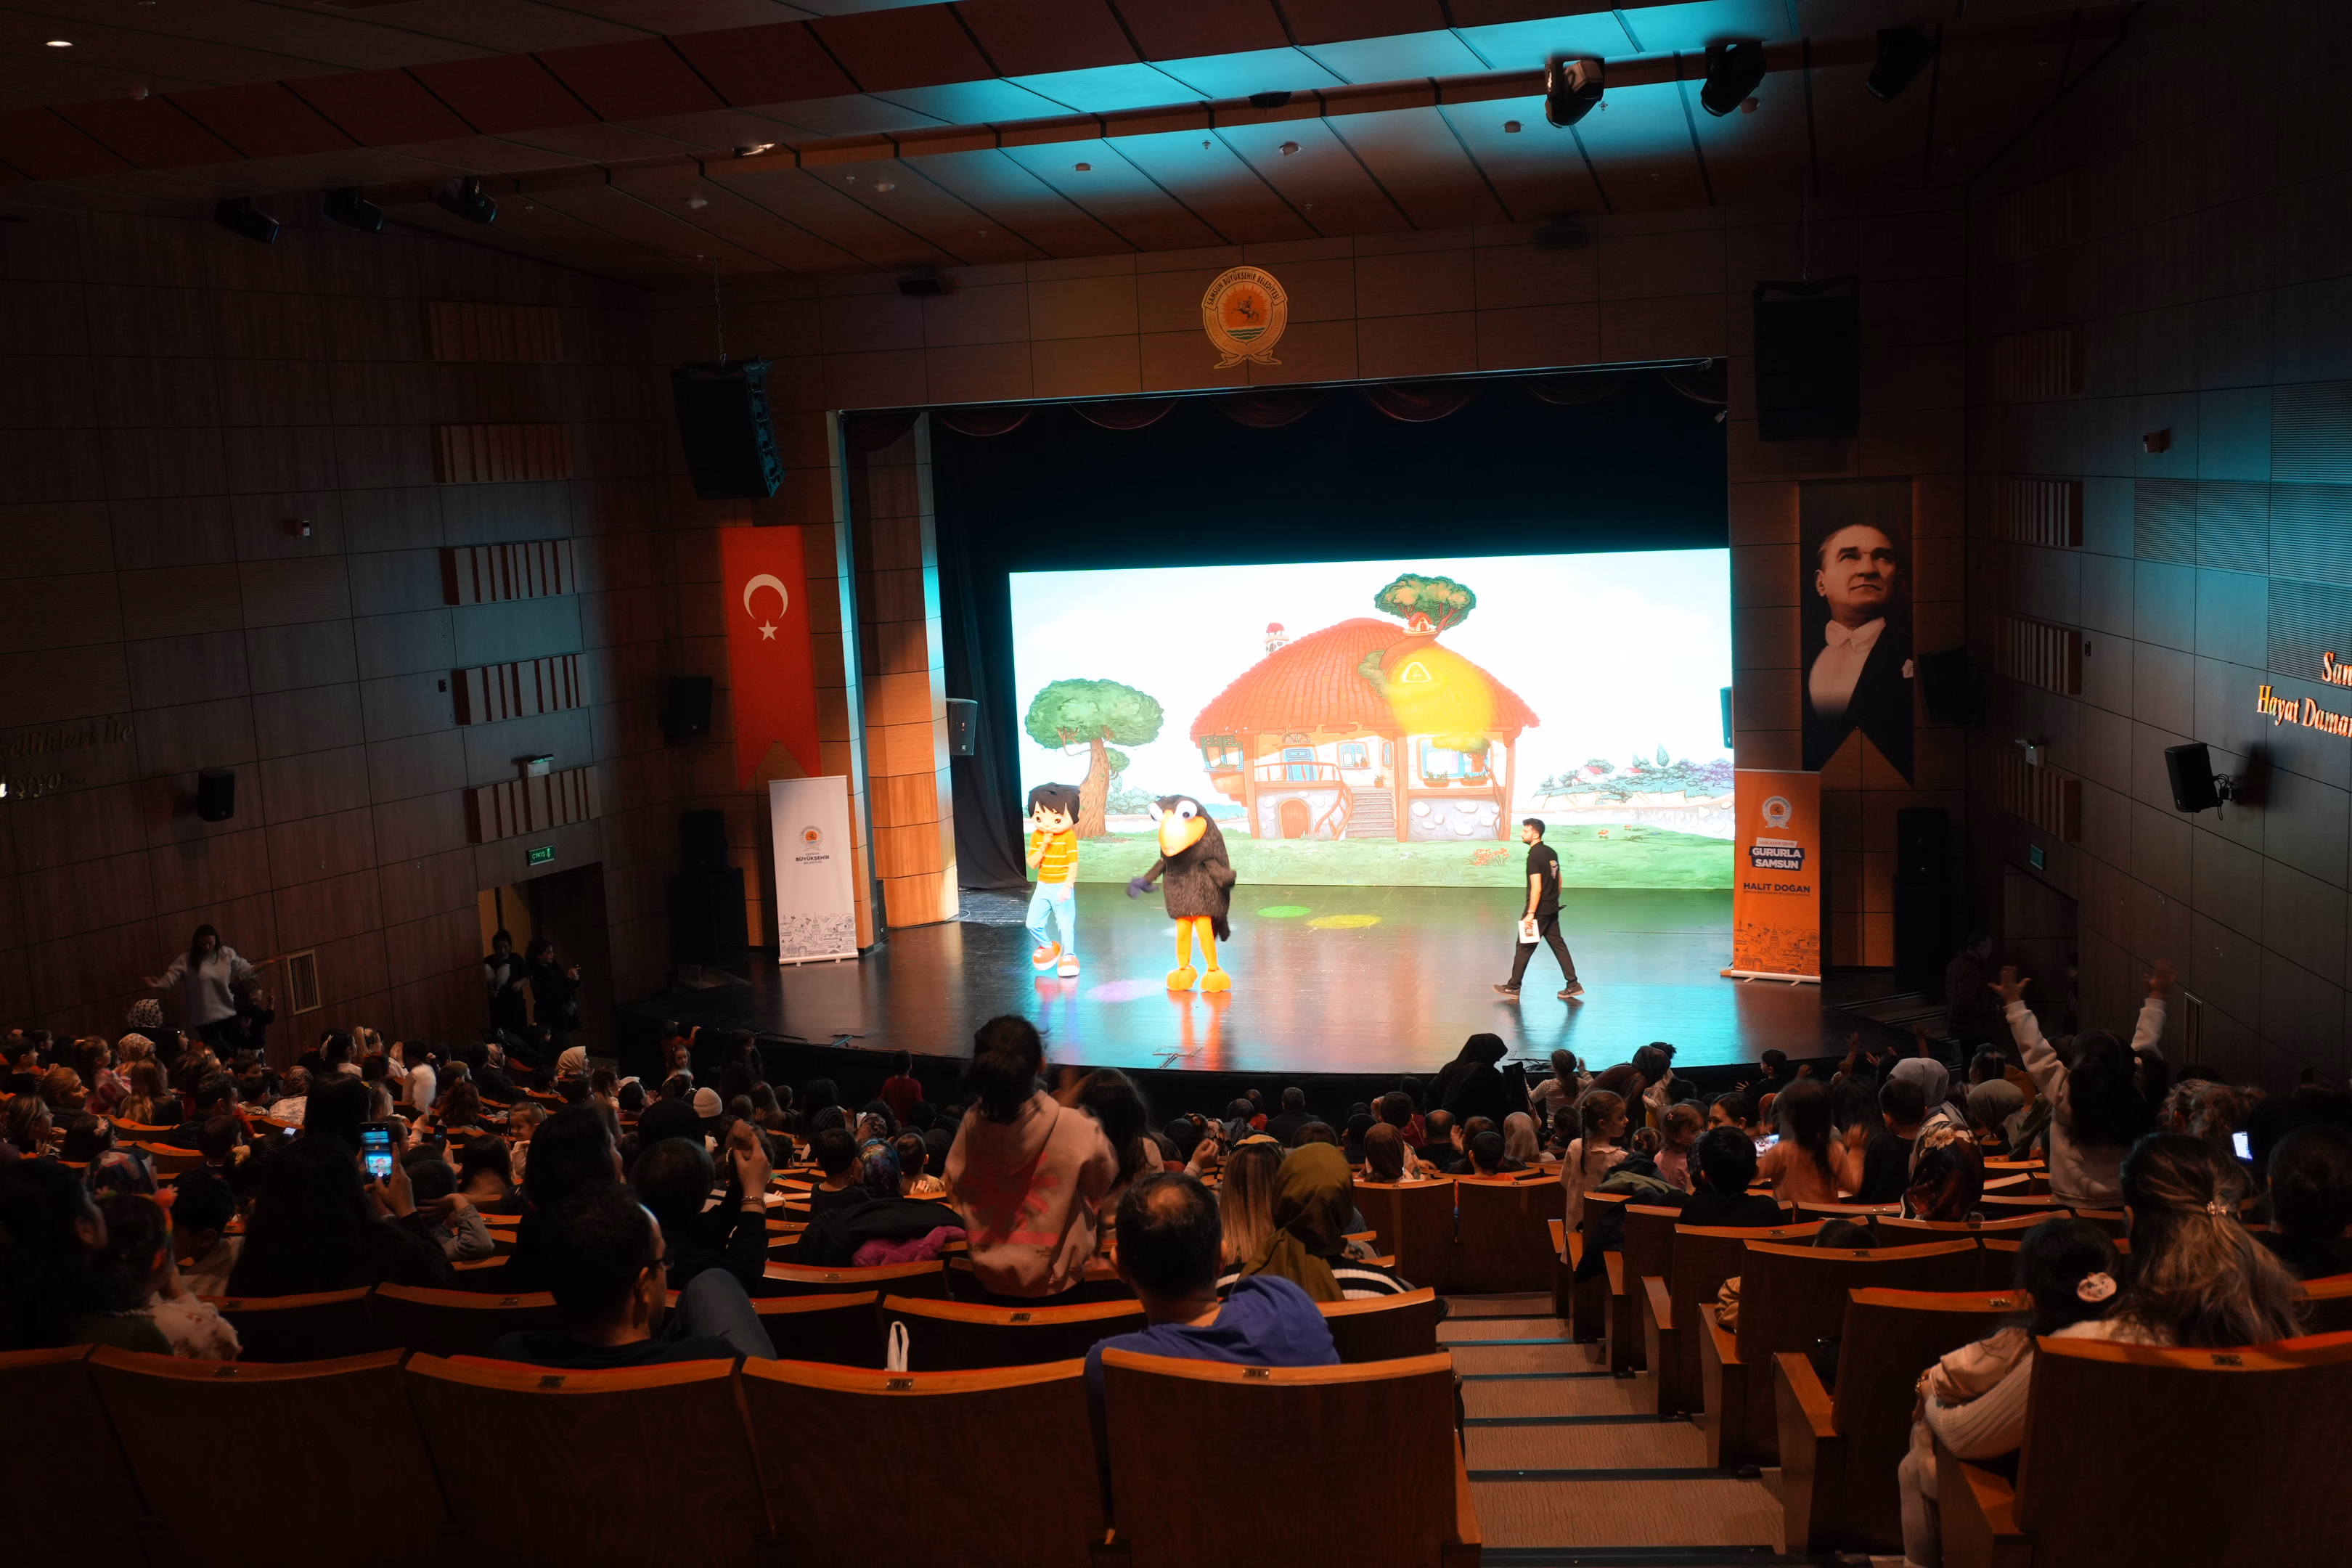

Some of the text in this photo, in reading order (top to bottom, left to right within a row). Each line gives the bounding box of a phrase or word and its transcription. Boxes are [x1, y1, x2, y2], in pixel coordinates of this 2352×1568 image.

[1206, 271, 1283, 306] SAMSUN BÜYÜKŞEHİR BELEDİYESİ
[2256, 685, 2300, 726] Hayat
[531, 851, 546, 859] ÇIKIŞ
[1752, 847, 1802, 858] GURURLA
[1755, 859, 1799, 869] SAMSUN
[1775, 883, 1810, 893] DOĞAN
